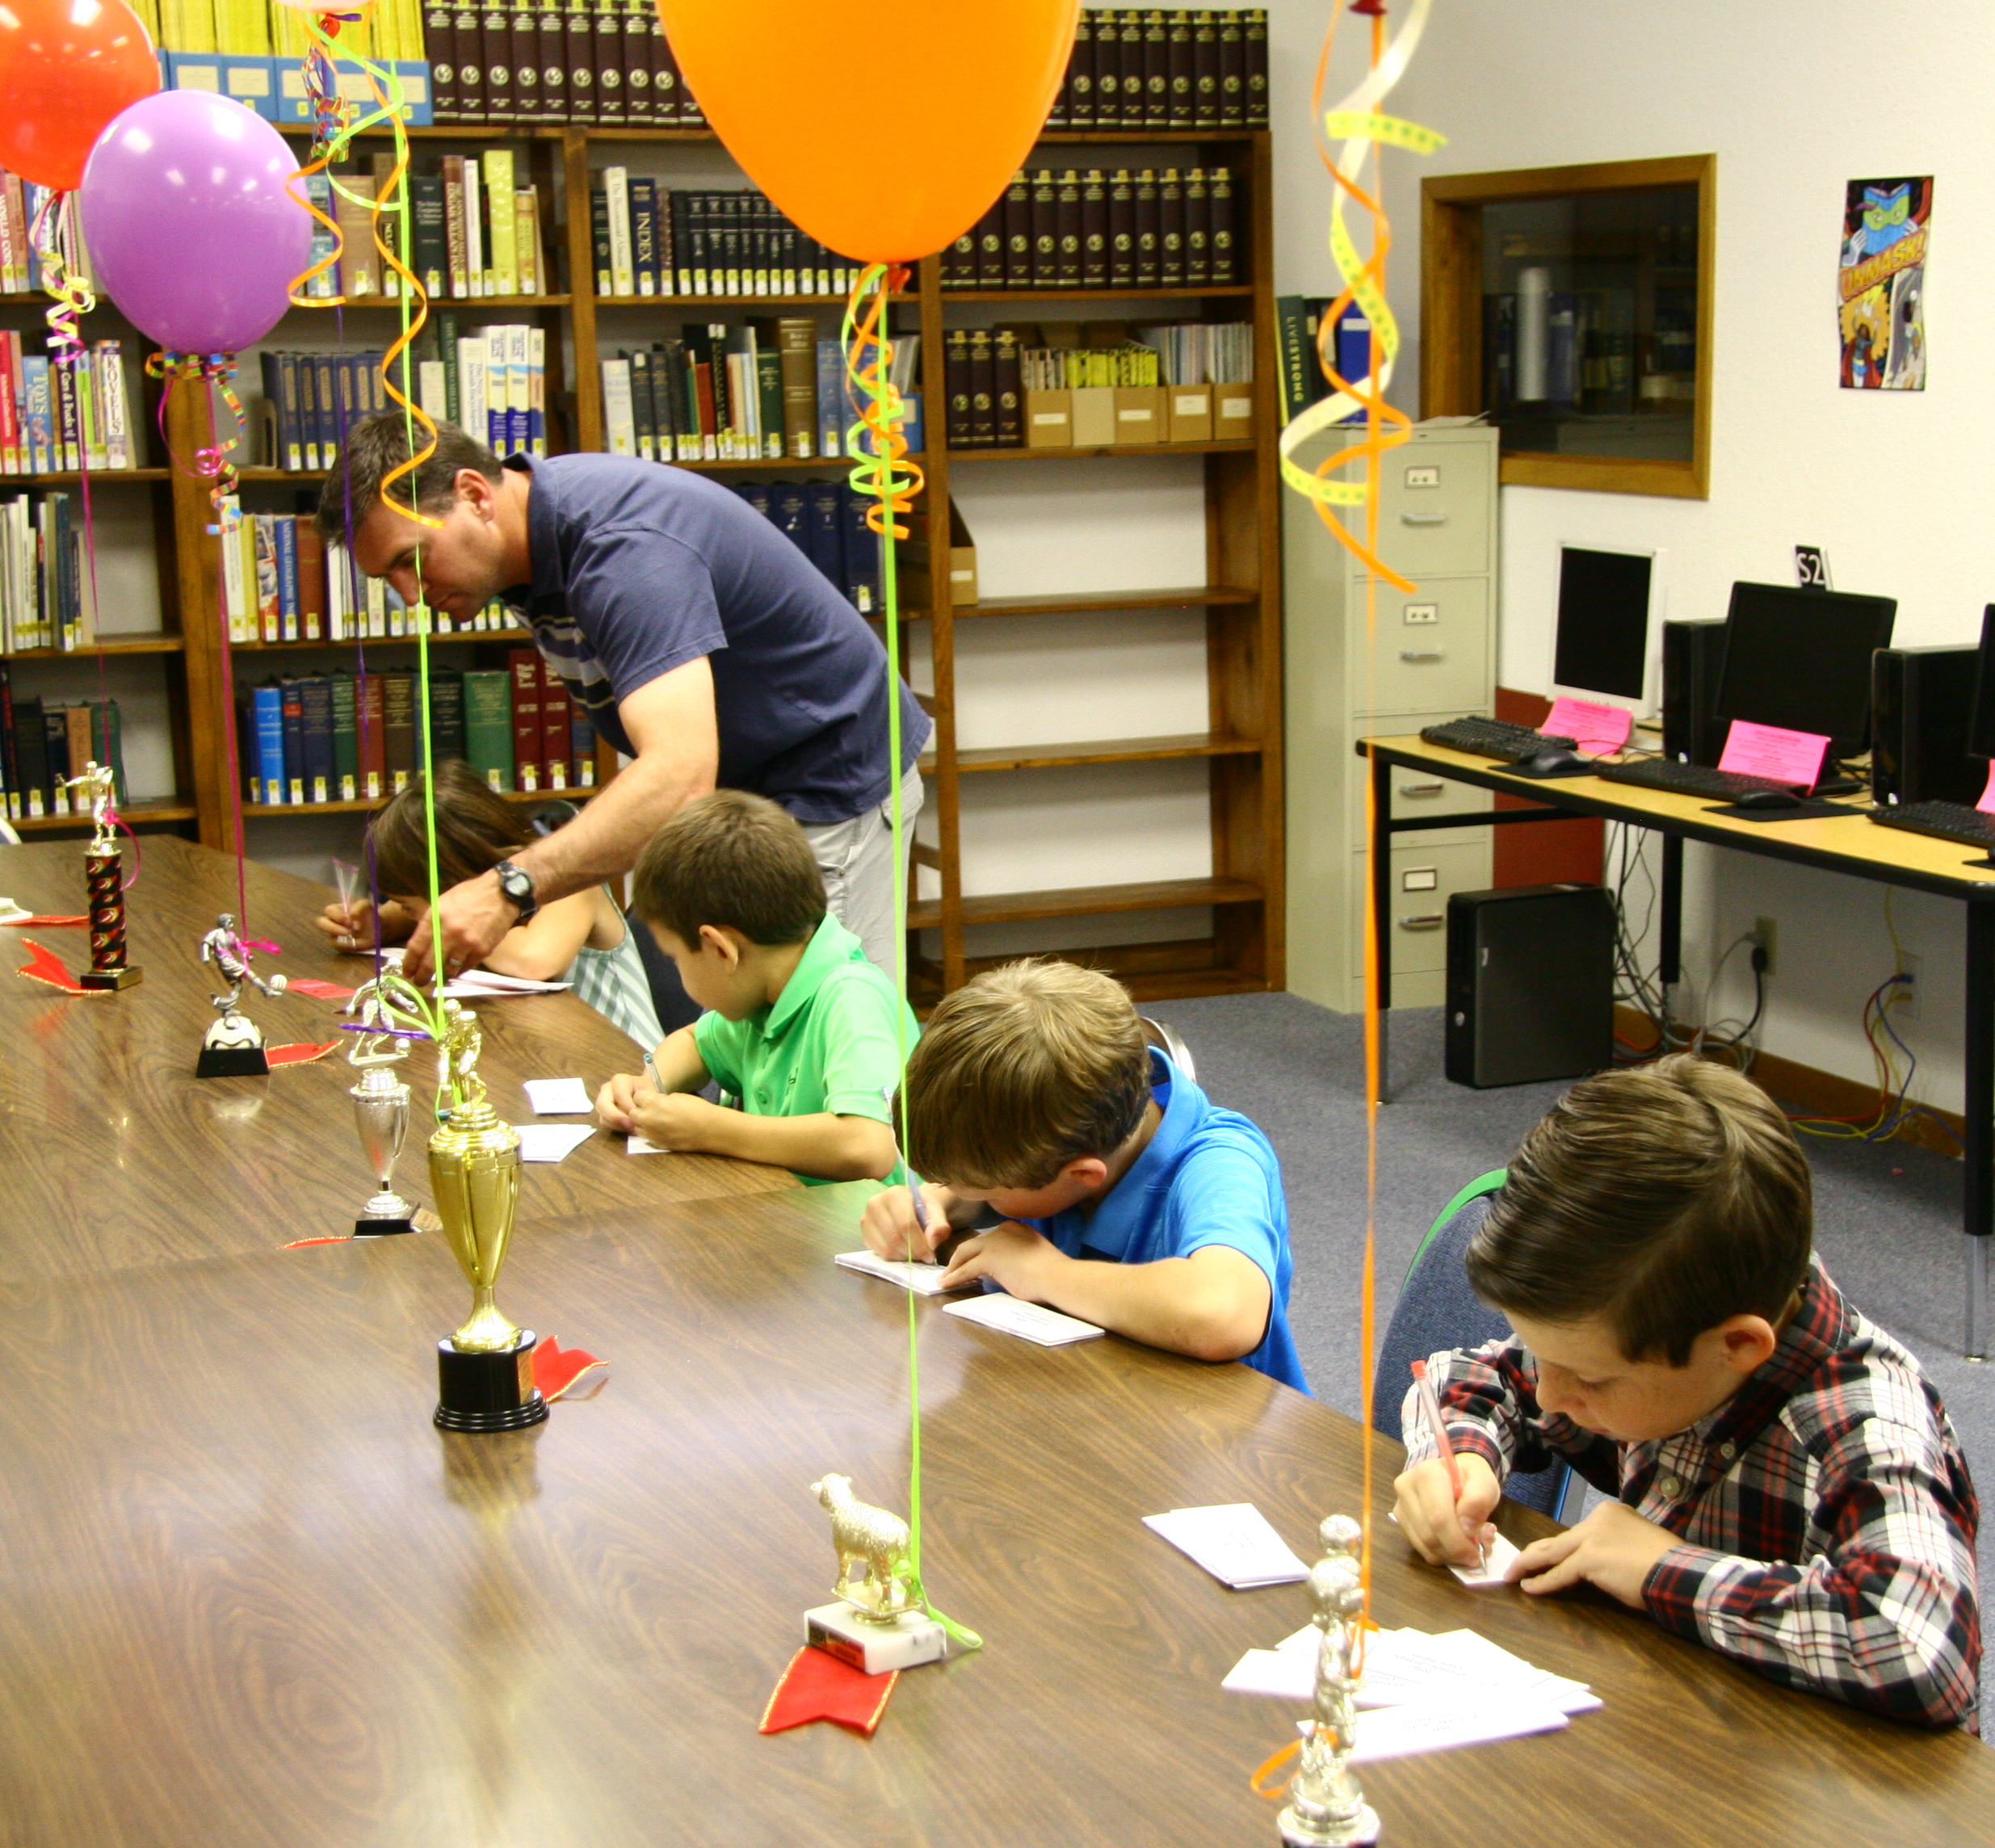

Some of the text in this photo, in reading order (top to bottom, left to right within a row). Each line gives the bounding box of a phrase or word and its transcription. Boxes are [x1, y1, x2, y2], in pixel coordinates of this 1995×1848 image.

[636, 212, 653, 263] INDEX
[1840, 229, 1926, 303] UNMASK!
[1287, 316, 1304, 402] LIVESTRONG
[61, 372, 73, 392] Cars
[284, 520, 292, 554] NATIONAL
[284, 555, 294, 599] GEOGRAPHIC
[1797, 552, 1825, 584] S2
